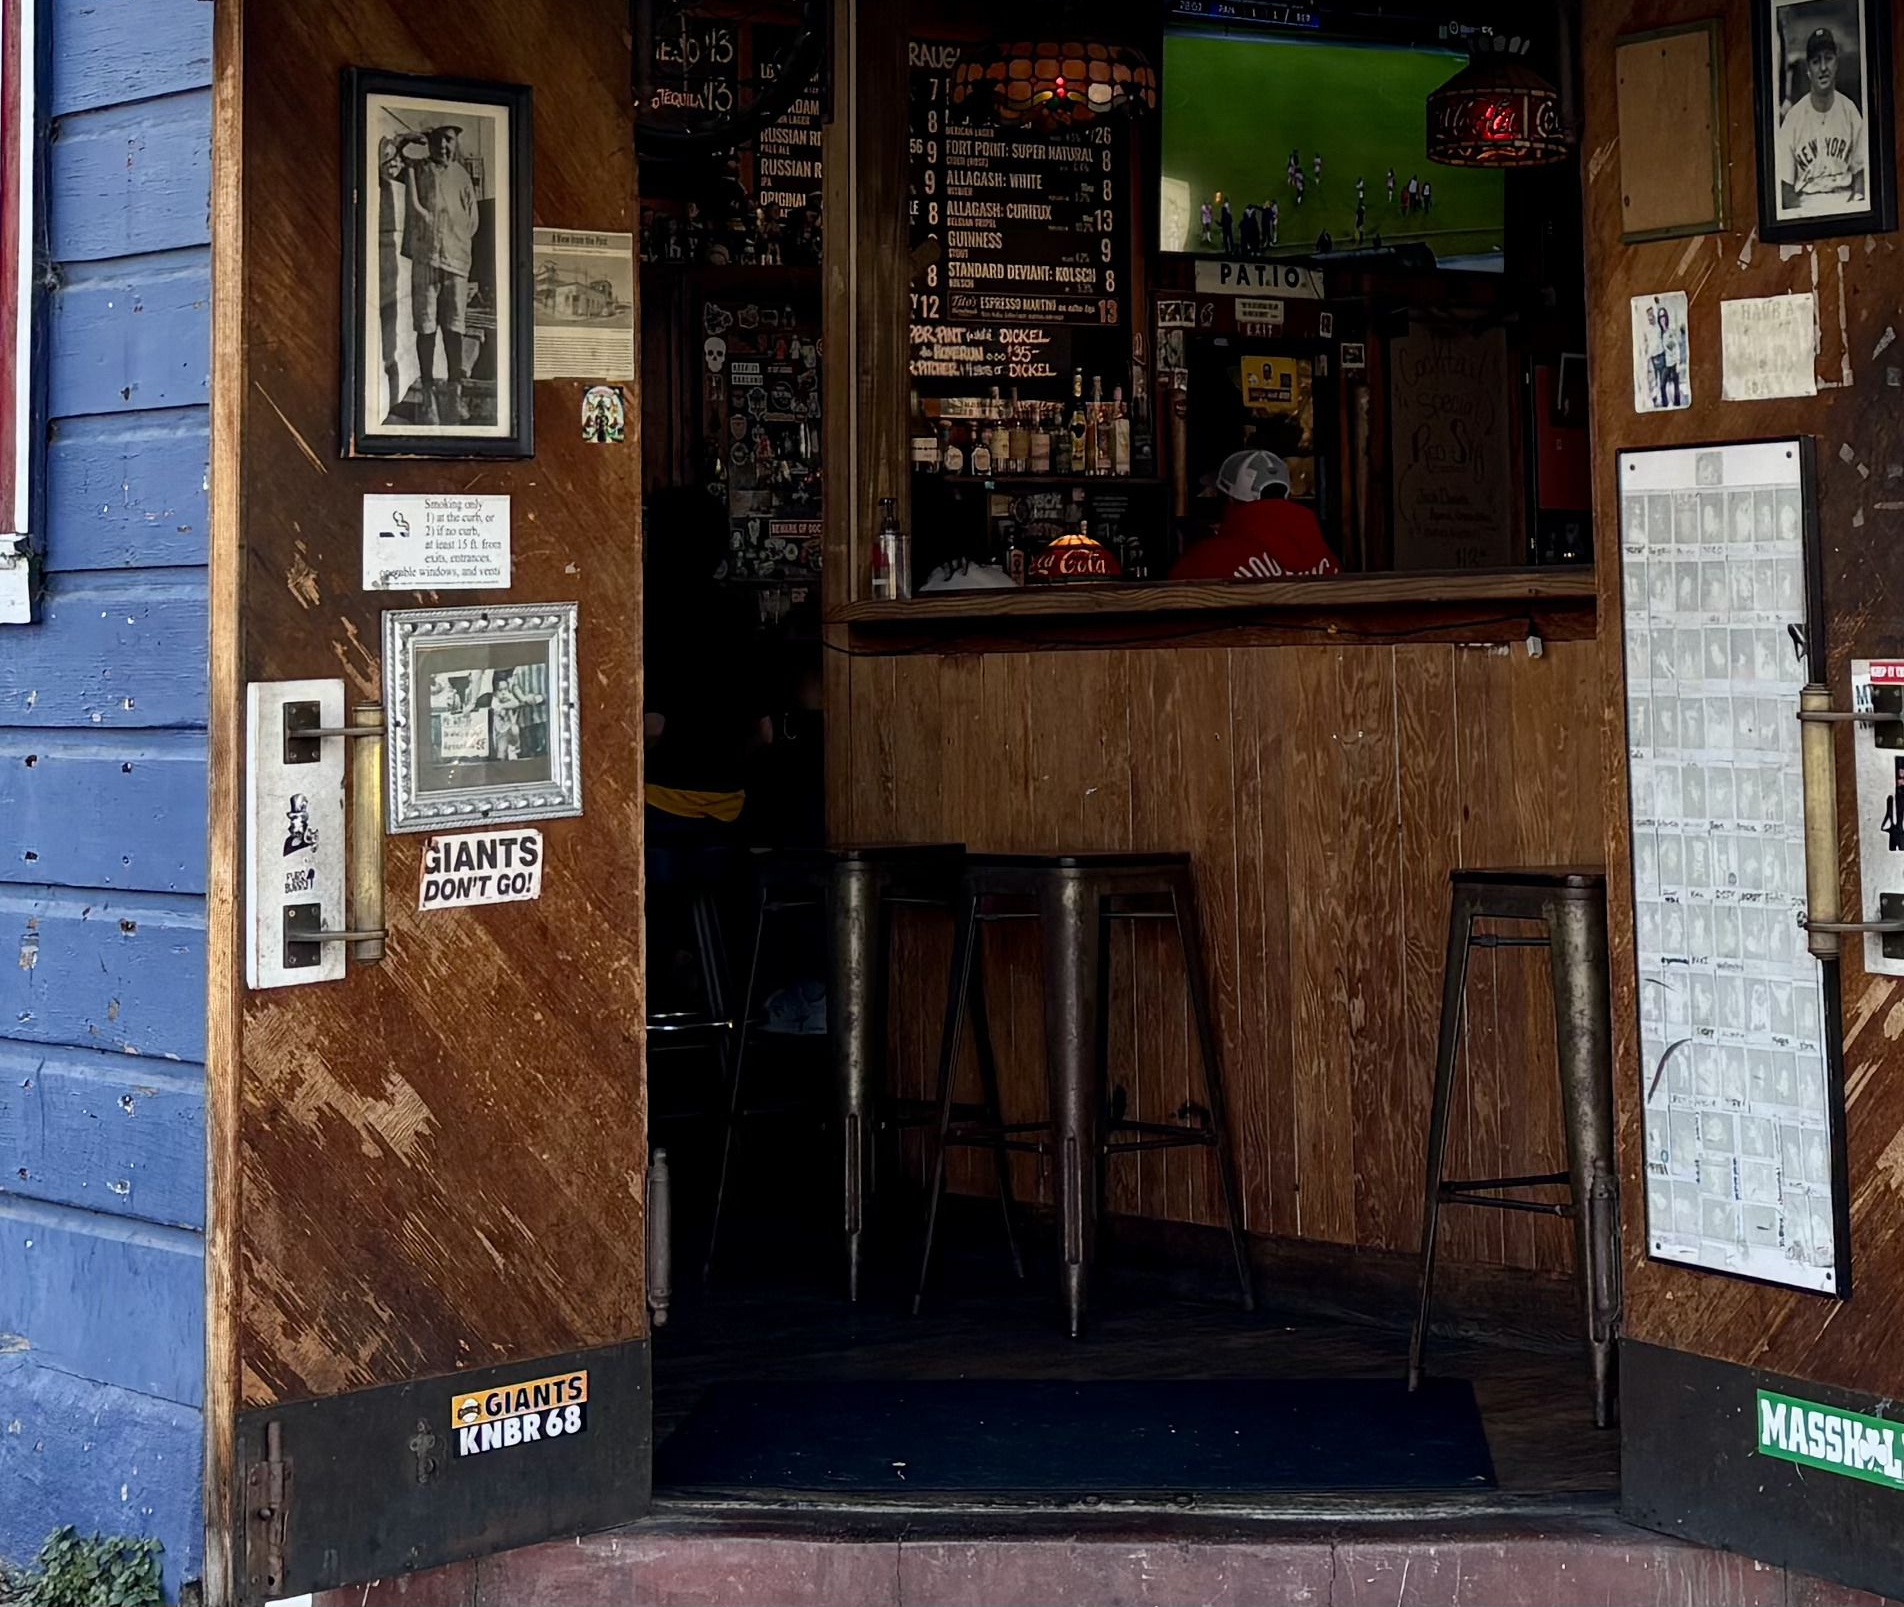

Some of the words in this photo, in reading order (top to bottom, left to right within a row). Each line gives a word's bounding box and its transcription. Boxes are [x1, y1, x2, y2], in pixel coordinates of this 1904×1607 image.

[928, 110, 937, 133] 8
[761, 127, 808, 146] RUSSIAN
[927, 140, 937, 164] 9
[946, 139, 972, 155] FORT
[975, 141, 1009, 158] POINT:
[1012, 143, 1046, 160] SUPER
[1048, 145, 1094, 163] NATURAL
[1102, 149, 1112, 172] 8
[1796, 138, 1818, 172] NEW
[761, 157, 812, 178] RUSSIAN
[924, 169, 936, 195] 9
[946, 169, 1007, 187] ALLAGASH:
[1009, 174, 1043, 190] WHITE
[1102, 179, 1112, 202] 8
[928, 202, 939, 225] 8
[946, 200, 1005, 218] ALLAGASH:
[1094, 209, 1114, 233] 13
[947, 230, 1003, 250] GUINNESS
[1100, 238, 1112, 263] 9
[927, 264, 938, 288] 8
[947, 261, 1005, 280] STANDARD
[1007, 265, 1053, 282] DEVIANT:
[1104, 269, 1116, 293] 8
[1220, 262, 1300, 289] PATIO
[920, 295, 940, 319] 12
[980, 296, 1022, 311] ESPRESSO
[1097, 298, 1119, 324] 13
[999, 328, 1051, 344] DICKEL
[1008, 363, 1058, 378] DICKEL
[424, 498, 462, 511] Smoking
[464, 498, 483, 512] only
[447, 512, 460, 523] the
[485, 514, 495, 523] or
[445, 527, 456, 537] no
[458, 526, 480, 537] curb,
[436, 539, 455, 550] least
[457, 539, 468, 550] 15
[482, 539, 502, 550] from
[461, 565, 478, 577] and
[1059, 548, 1106, 575] Cola
[424, 836, 539, 875] GIANTS
[424, 876, 491, 902] DON'T
[497, 872, 534, 896] GO!
[485, 1376, 583, 1417] GIANTS
[460, 1413, 542, 1457] KNBR
[545, 1404, 582, 1438] 68
